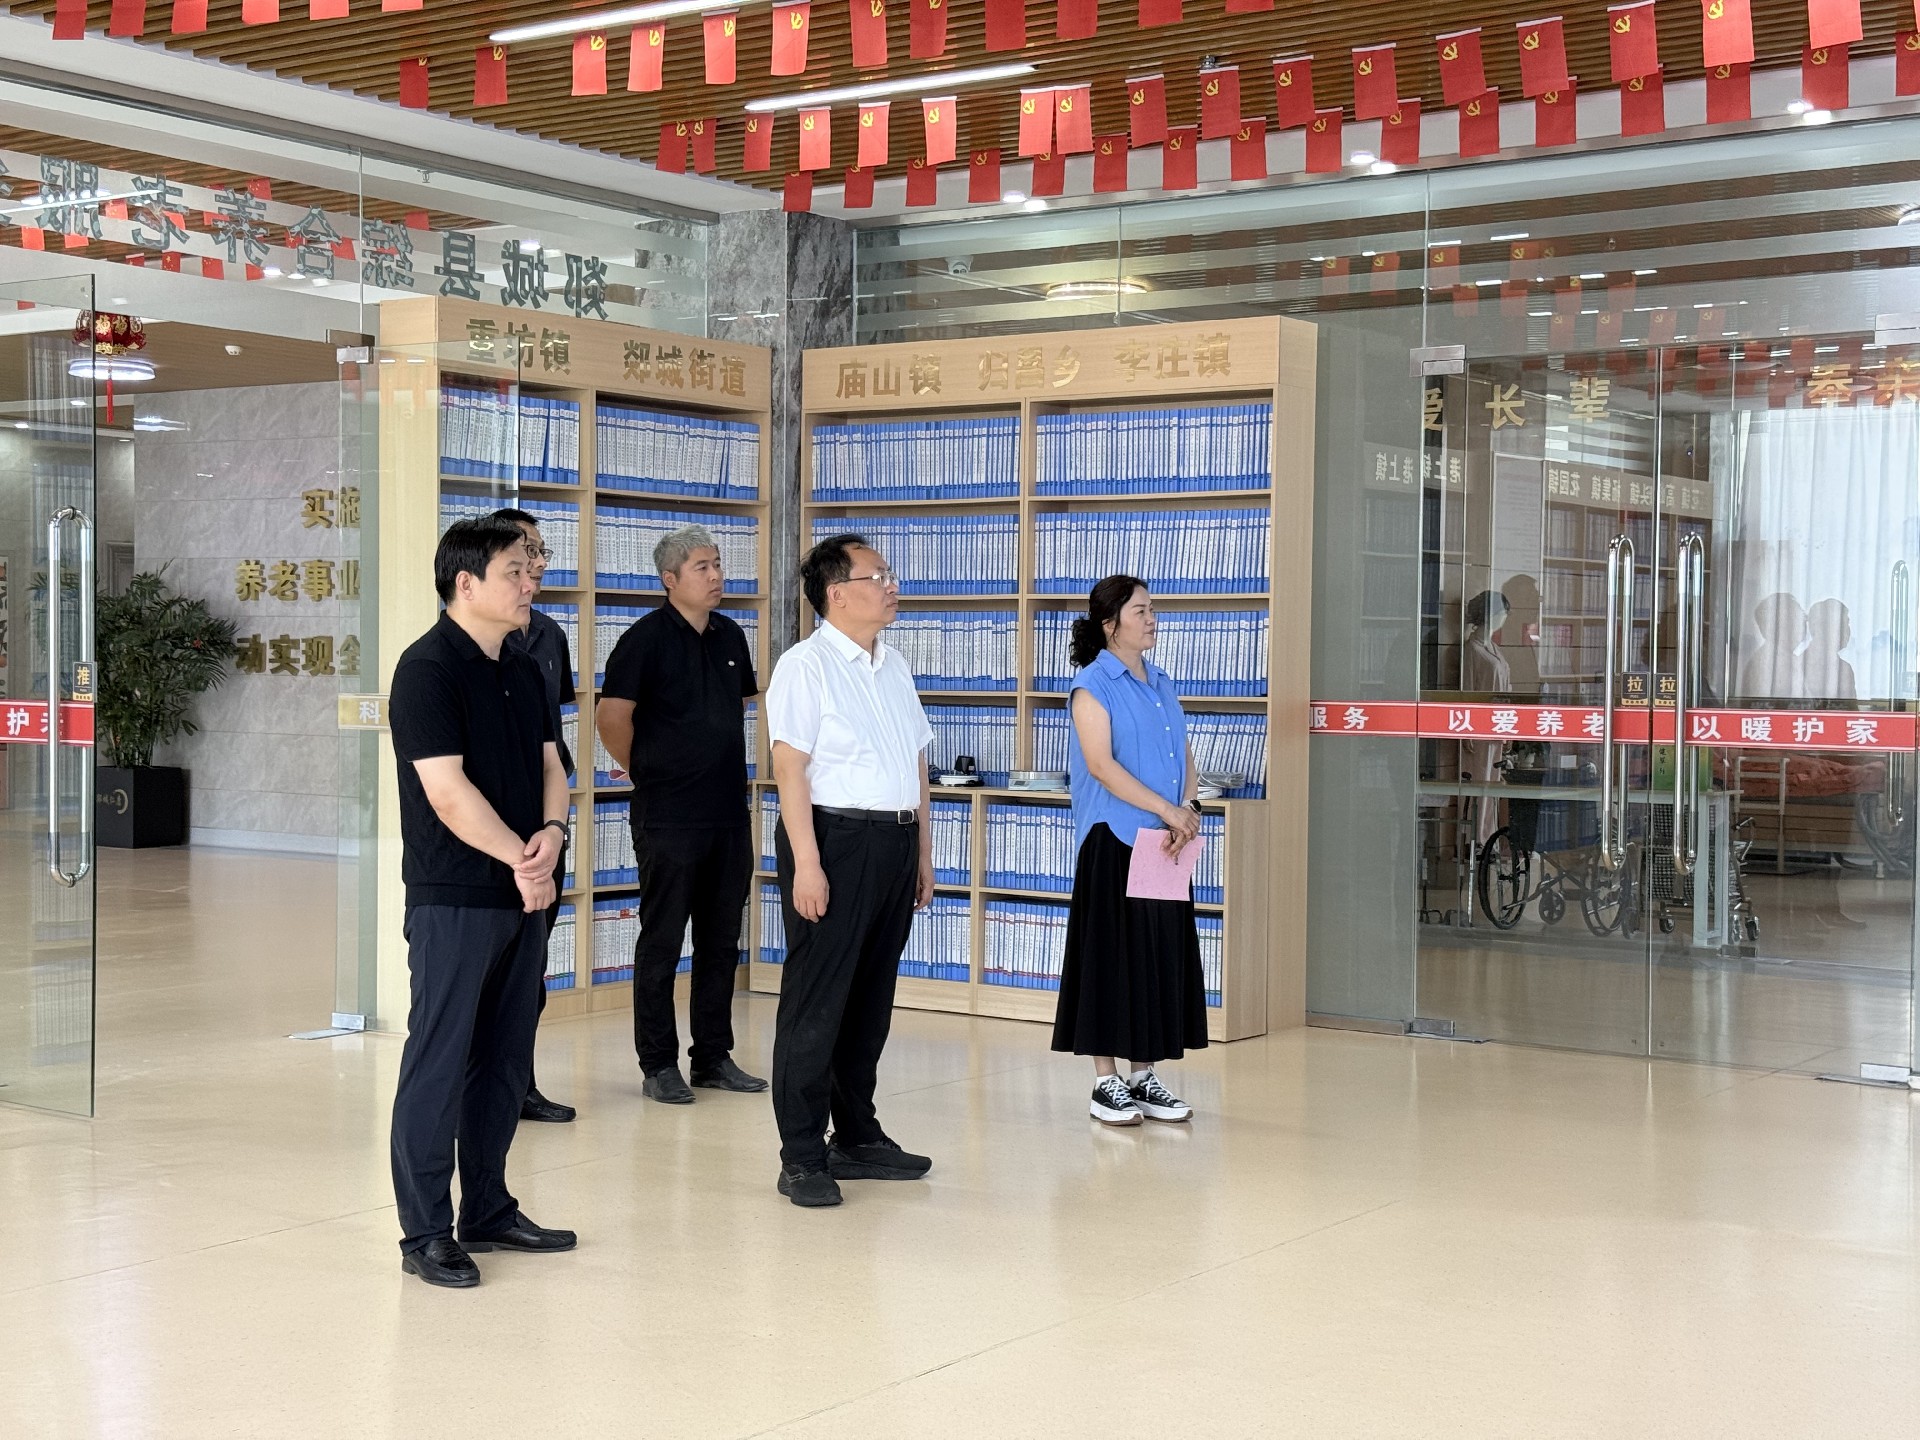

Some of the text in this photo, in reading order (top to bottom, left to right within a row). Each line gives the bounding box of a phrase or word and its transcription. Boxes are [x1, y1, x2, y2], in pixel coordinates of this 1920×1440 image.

[466, 318, 747, 397] 重坊镇 郯城街道
[835, 331, 1231, 400] 庙山镇 归昌乡 李庄镇
[301, 486, 361, 529] 实施
[235, 559, 361, 602] 养老事业
[76, 665, 91, 686] 推
[1627, 675, 1644, 692] 拉
[1659, 676, 1676, 693] 拉
[359, 701, 381, 724] 科
[1309, 706, 1879, 744] 服务 以爱养老 以暖护家
